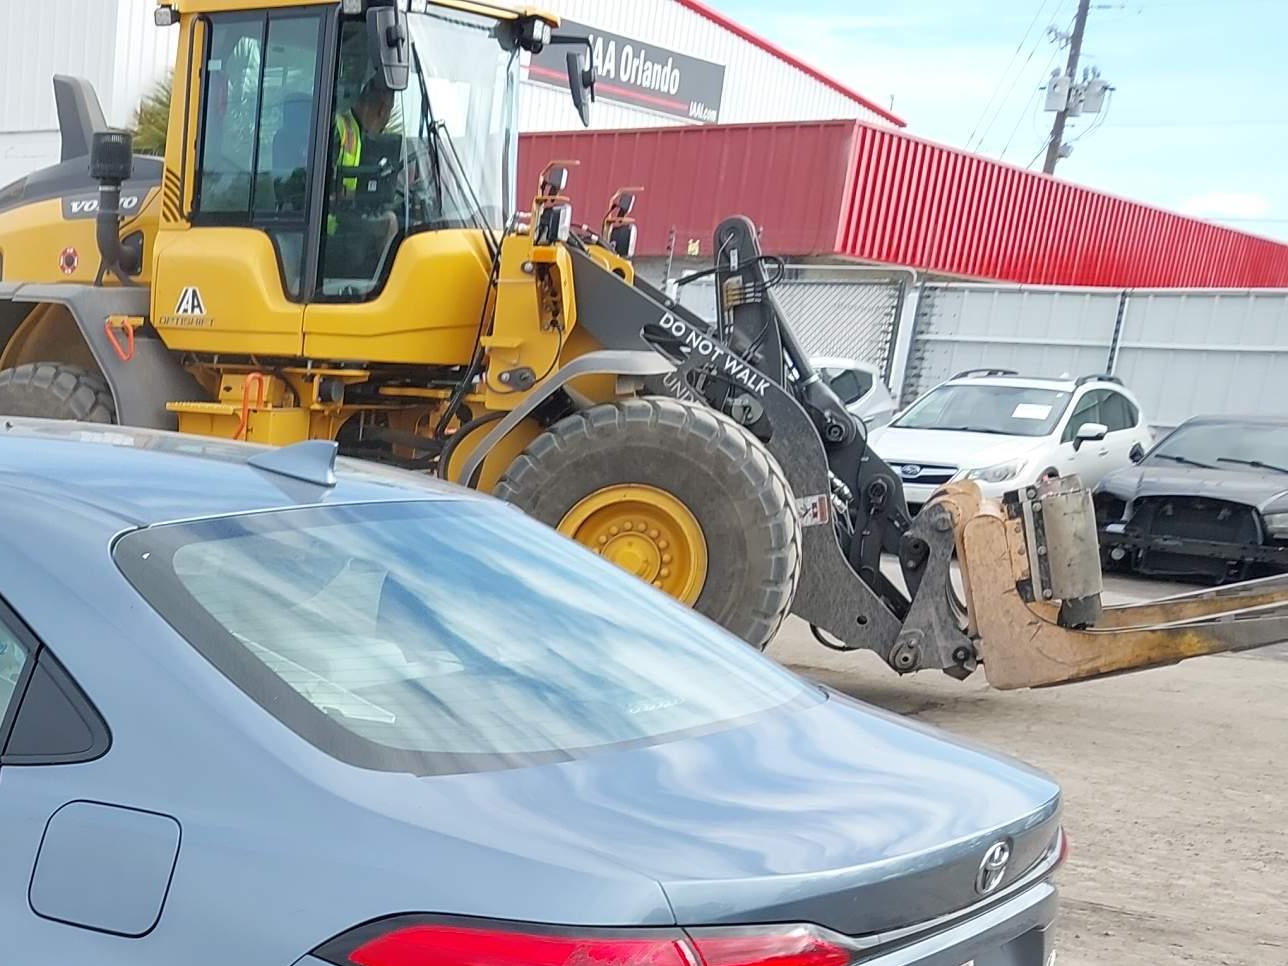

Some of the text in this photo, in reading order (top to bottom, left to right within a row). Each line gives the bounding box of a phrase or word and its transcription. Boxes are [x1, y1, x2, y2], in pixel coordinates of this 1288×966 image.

[620, 44, 680, 95] Orlando
[71, 196, 139, 213] VOO
[659, 312, 771, 396] DO NOT WALK
